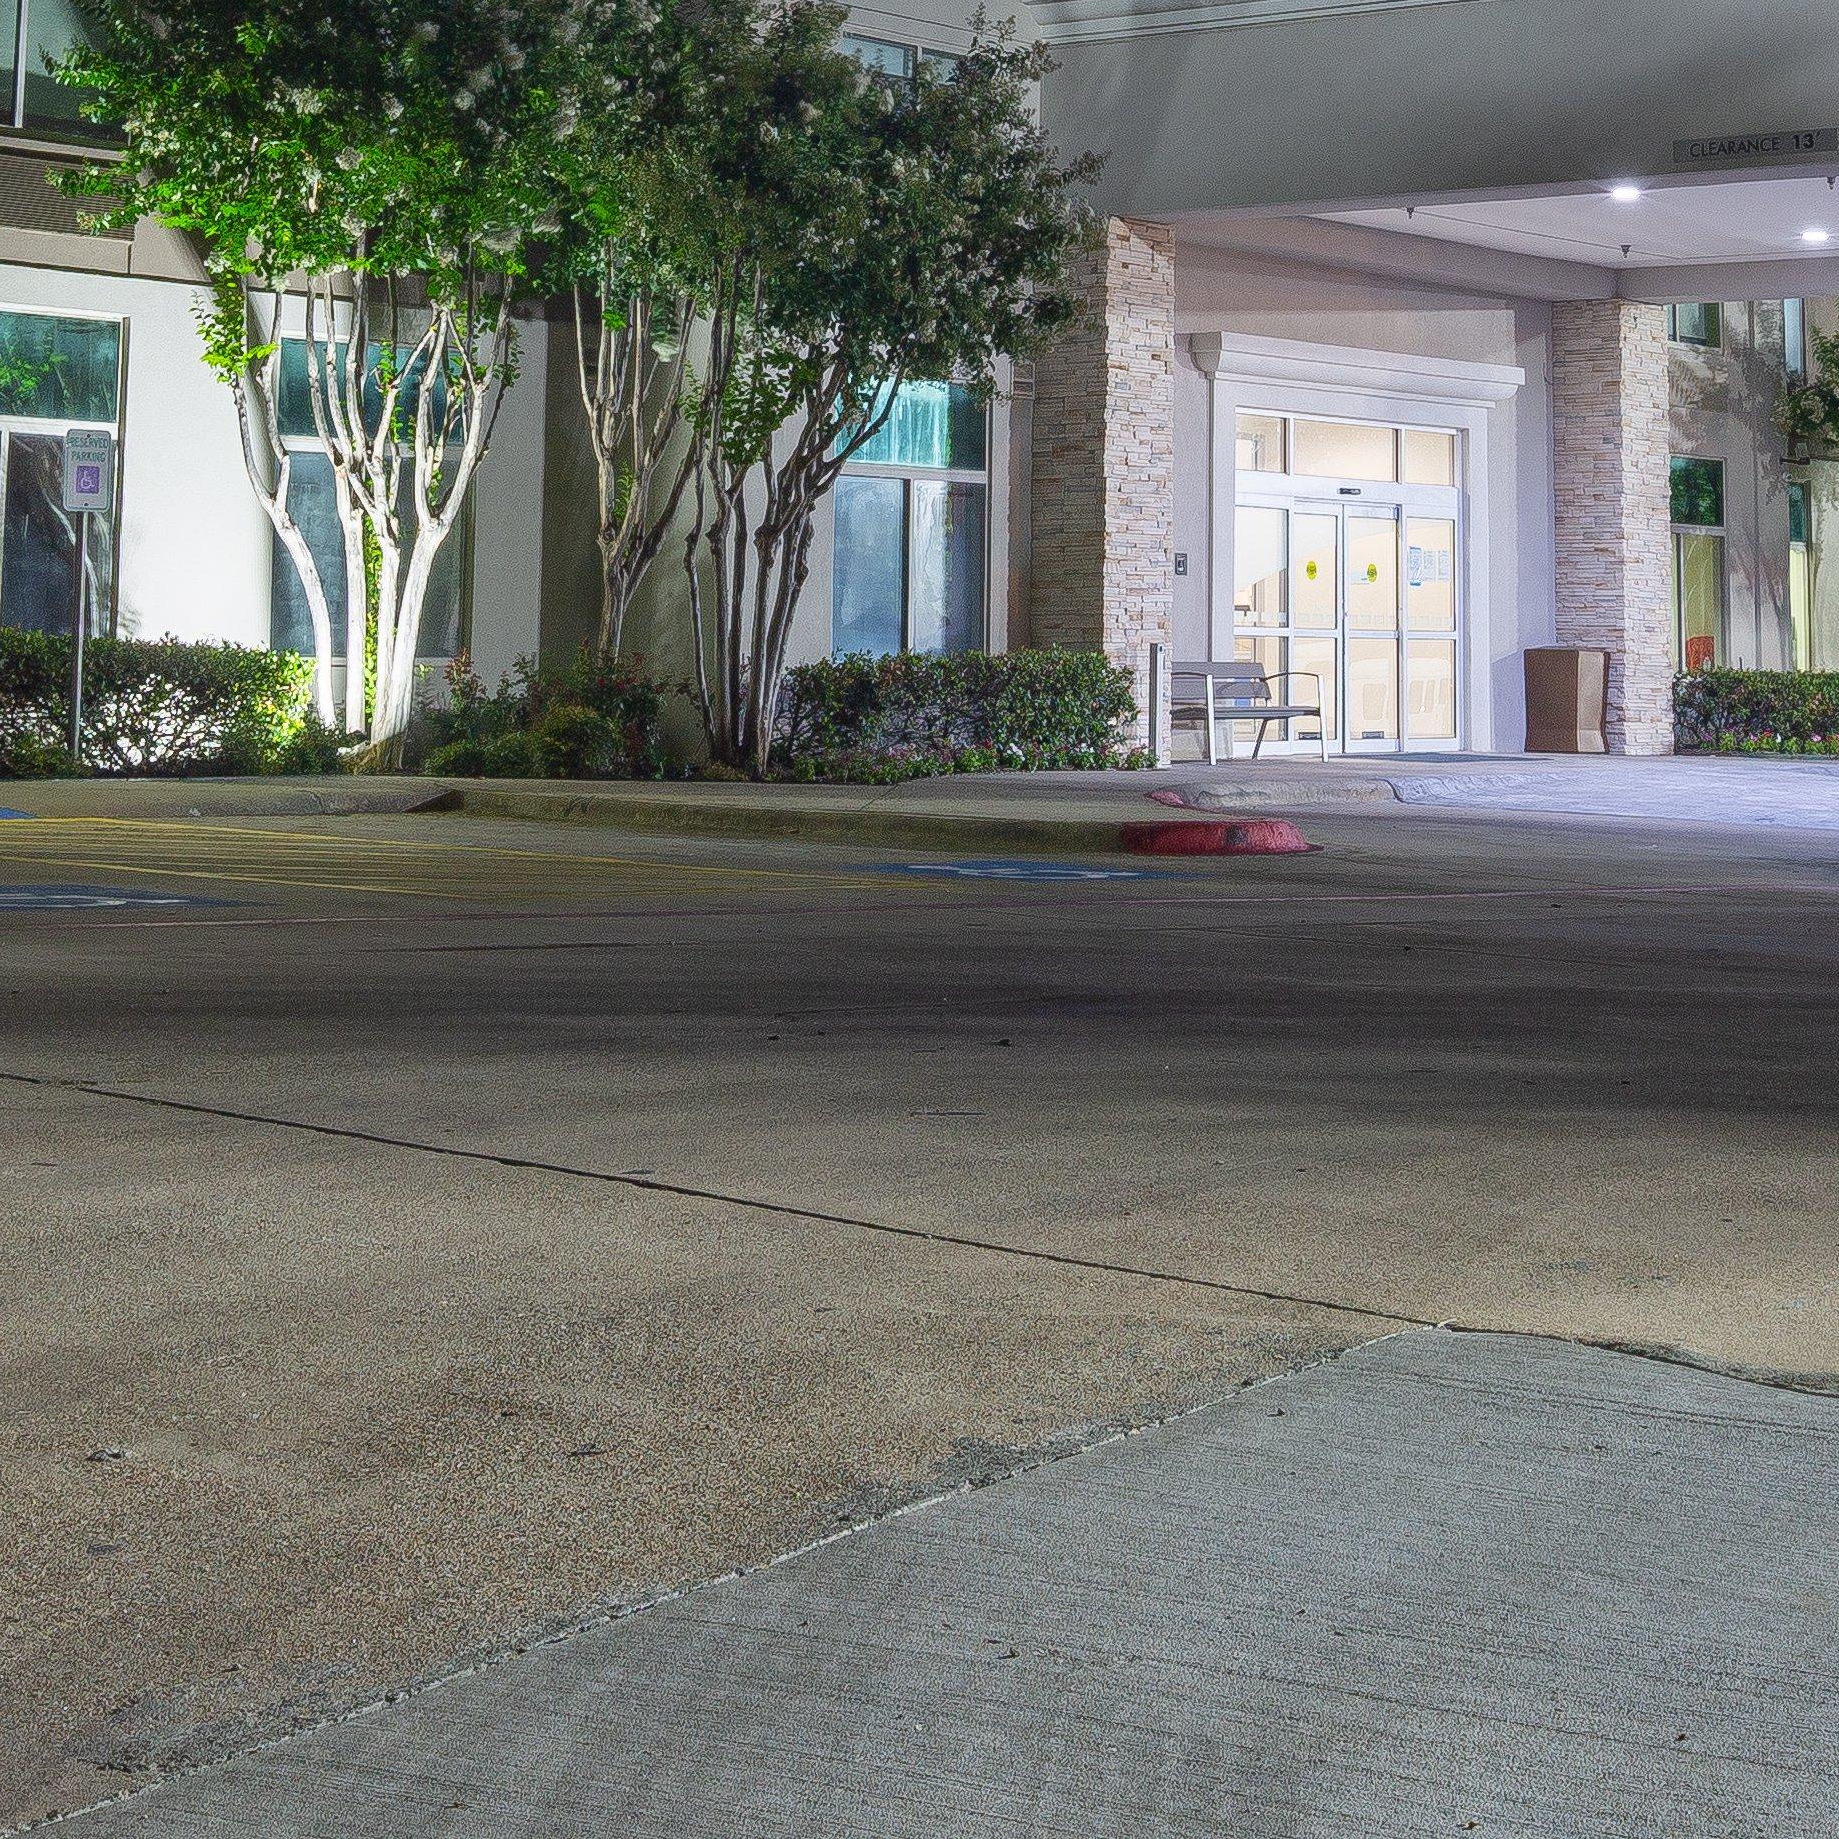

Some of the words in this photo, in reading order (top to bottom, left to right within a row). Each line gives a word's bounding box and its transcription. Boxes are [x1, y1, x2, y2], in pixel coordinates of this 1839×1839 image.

[1689, 136, 1781, 157] CLEARANCE
[66, 436, 109, 448] RESERVED
[71, 451, 106, 462] PARKING
